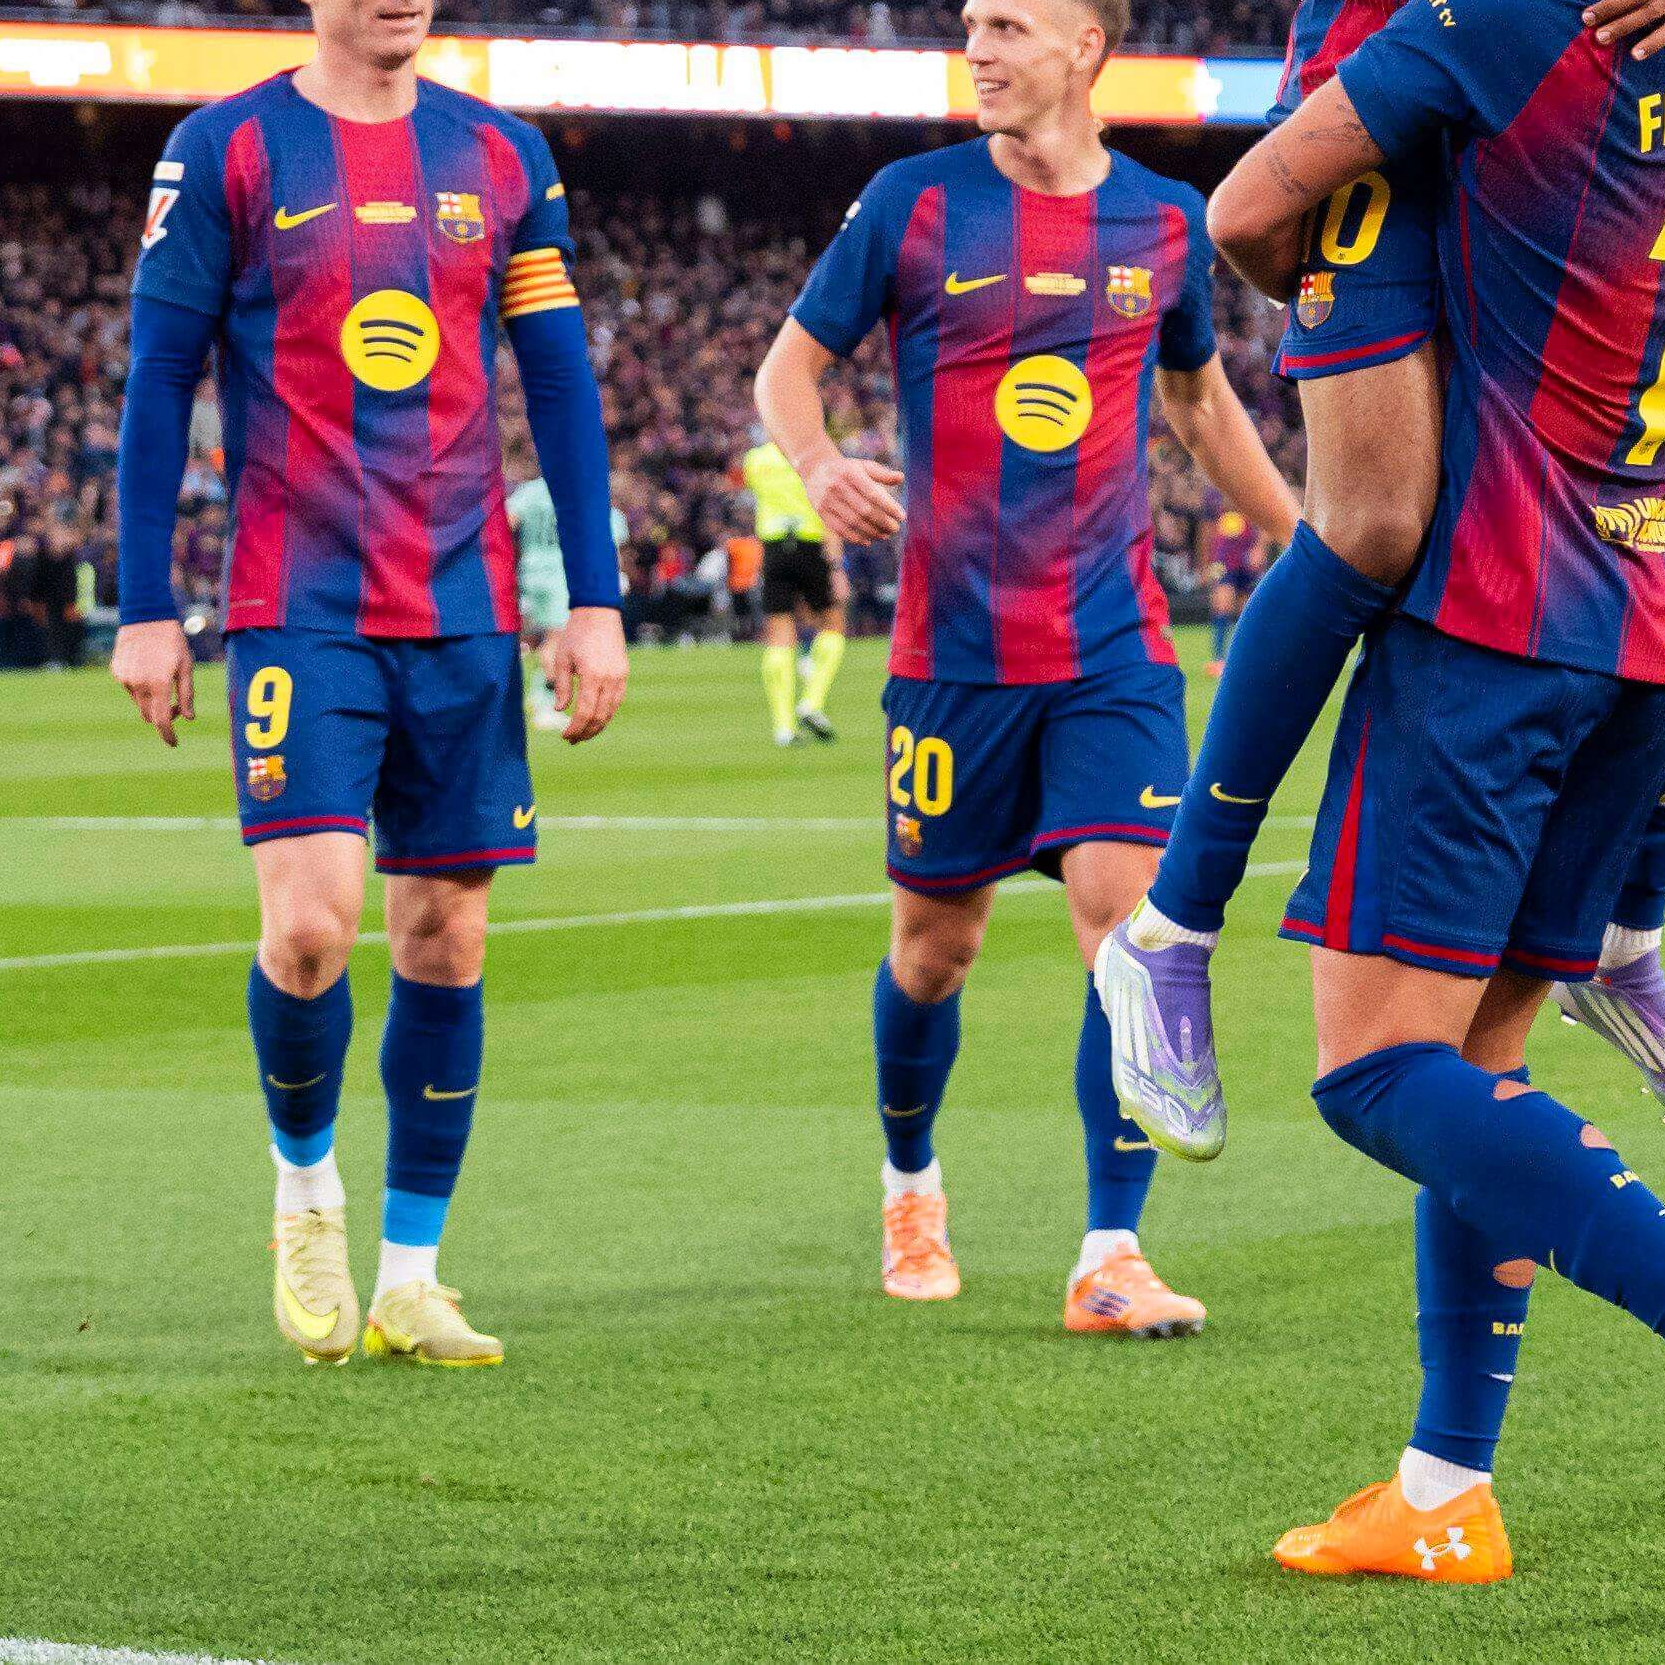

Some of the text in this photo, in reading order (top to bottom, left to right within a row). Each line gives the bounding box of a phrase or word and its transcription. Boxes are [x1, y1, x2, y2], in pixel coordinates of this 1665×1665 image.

[1438, 8, 1457, 28] tv
[245, 666, 293, 749] 9
[889, 725, 954, 817] 20
